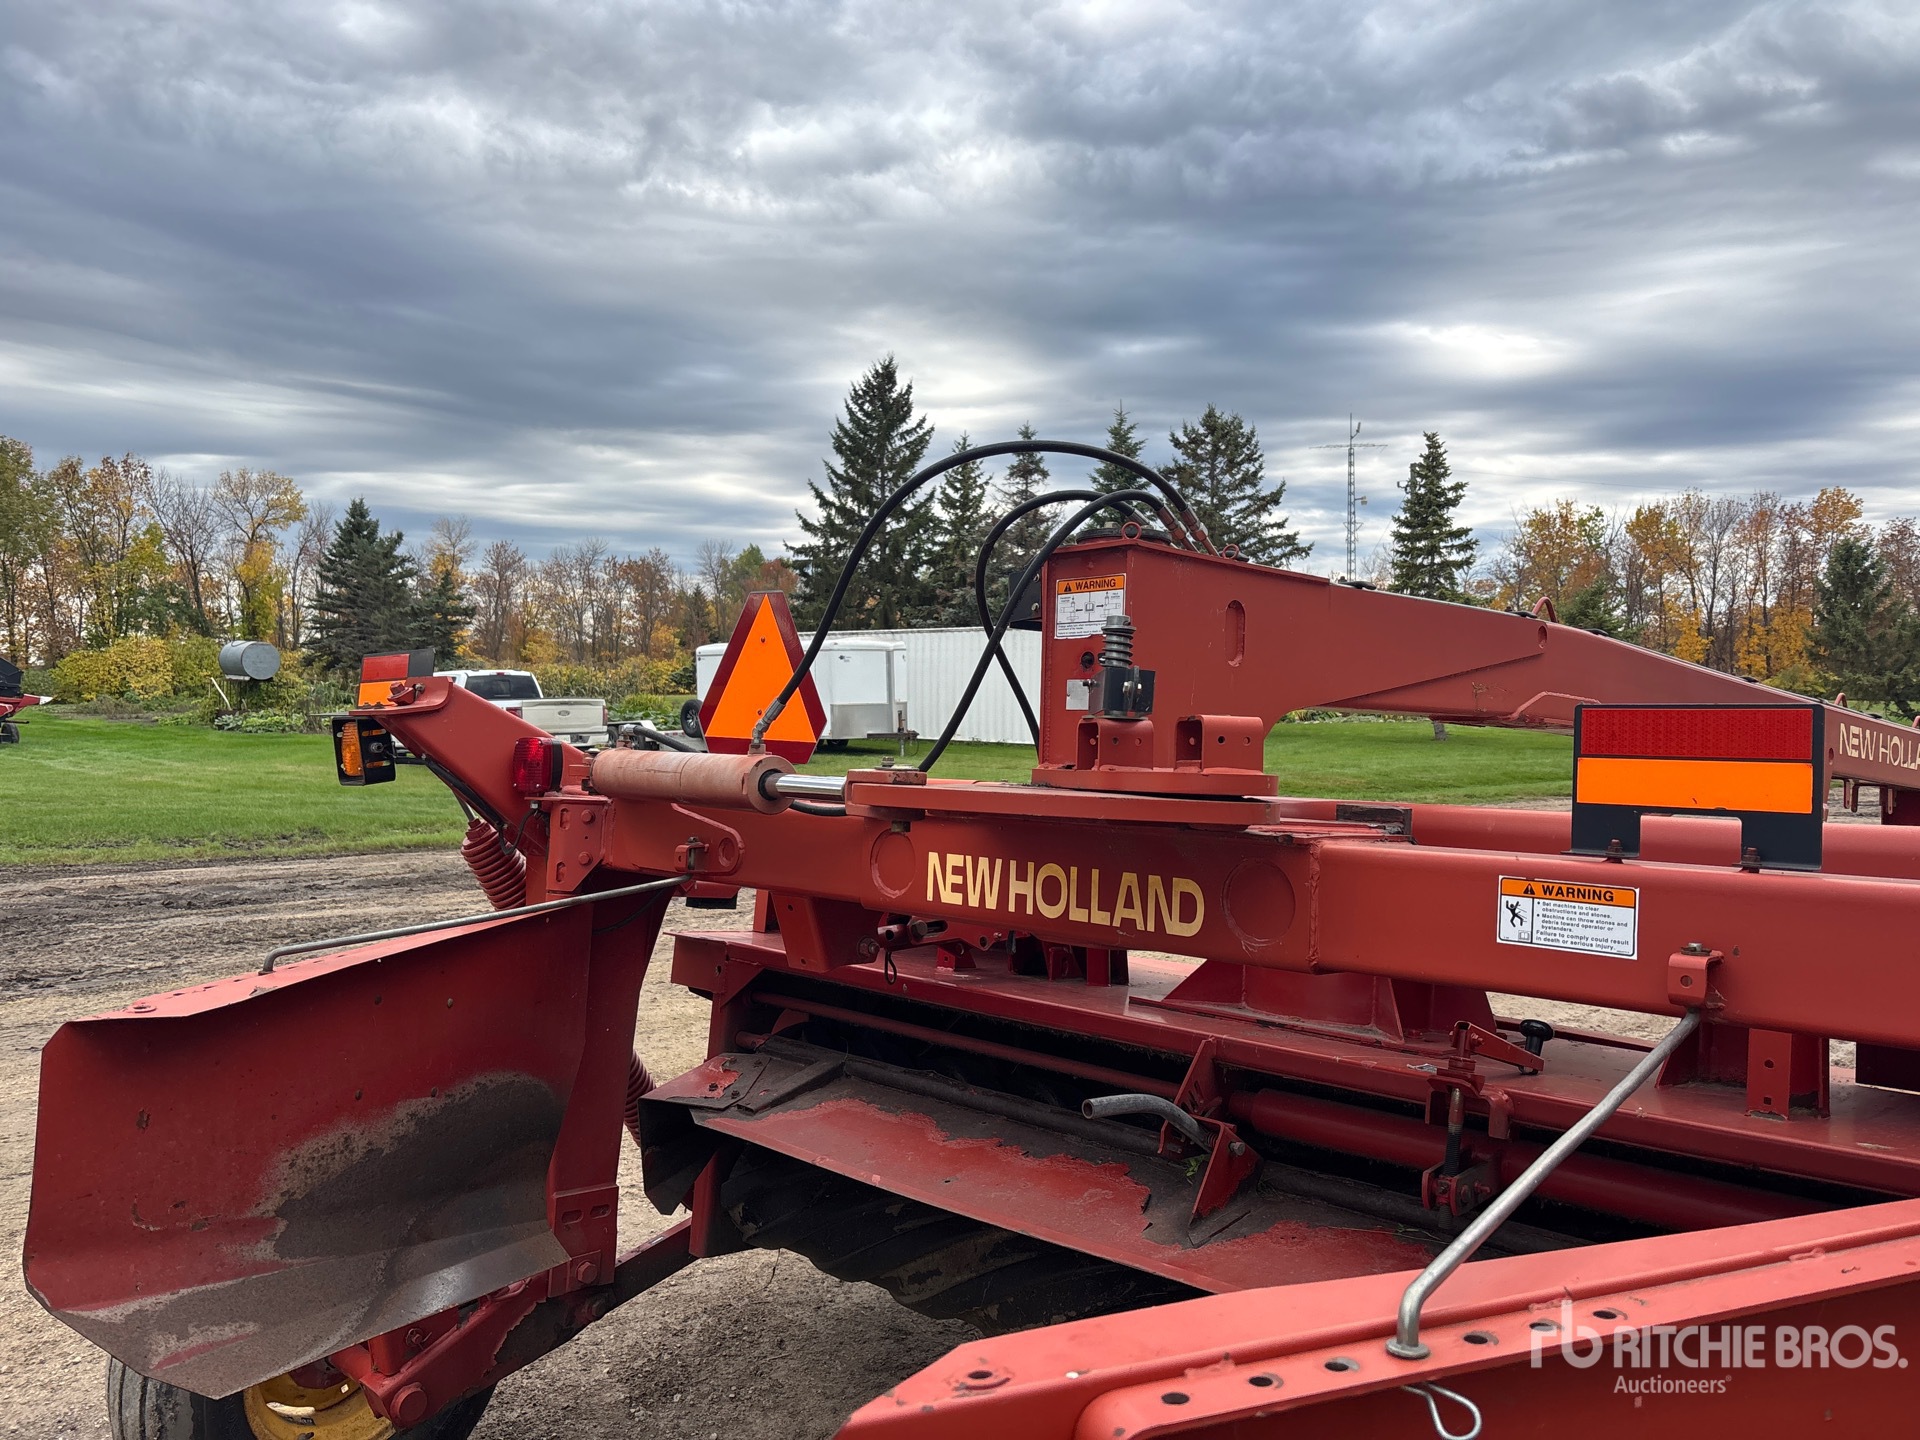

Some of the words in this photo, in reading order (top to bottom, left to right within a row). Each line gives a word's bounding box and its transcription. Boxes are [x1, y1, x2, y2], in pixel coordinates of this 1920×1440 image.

[1076, 578, 1116, 590] WARNING
[1840, 723, 1876, 760] NEW
[927, 851, 1002, 910] NEW
[1008, 860, 1205, 937] HOLLAND
[1542, 884, 1614, 902] WARNING
[1542, 907, 1577, 915] obstructions
[1541, 925, 1574, 933] bystanders.
[1567, 934, 1589, 942] comply
[1570, 940, 1593, 948] serious
